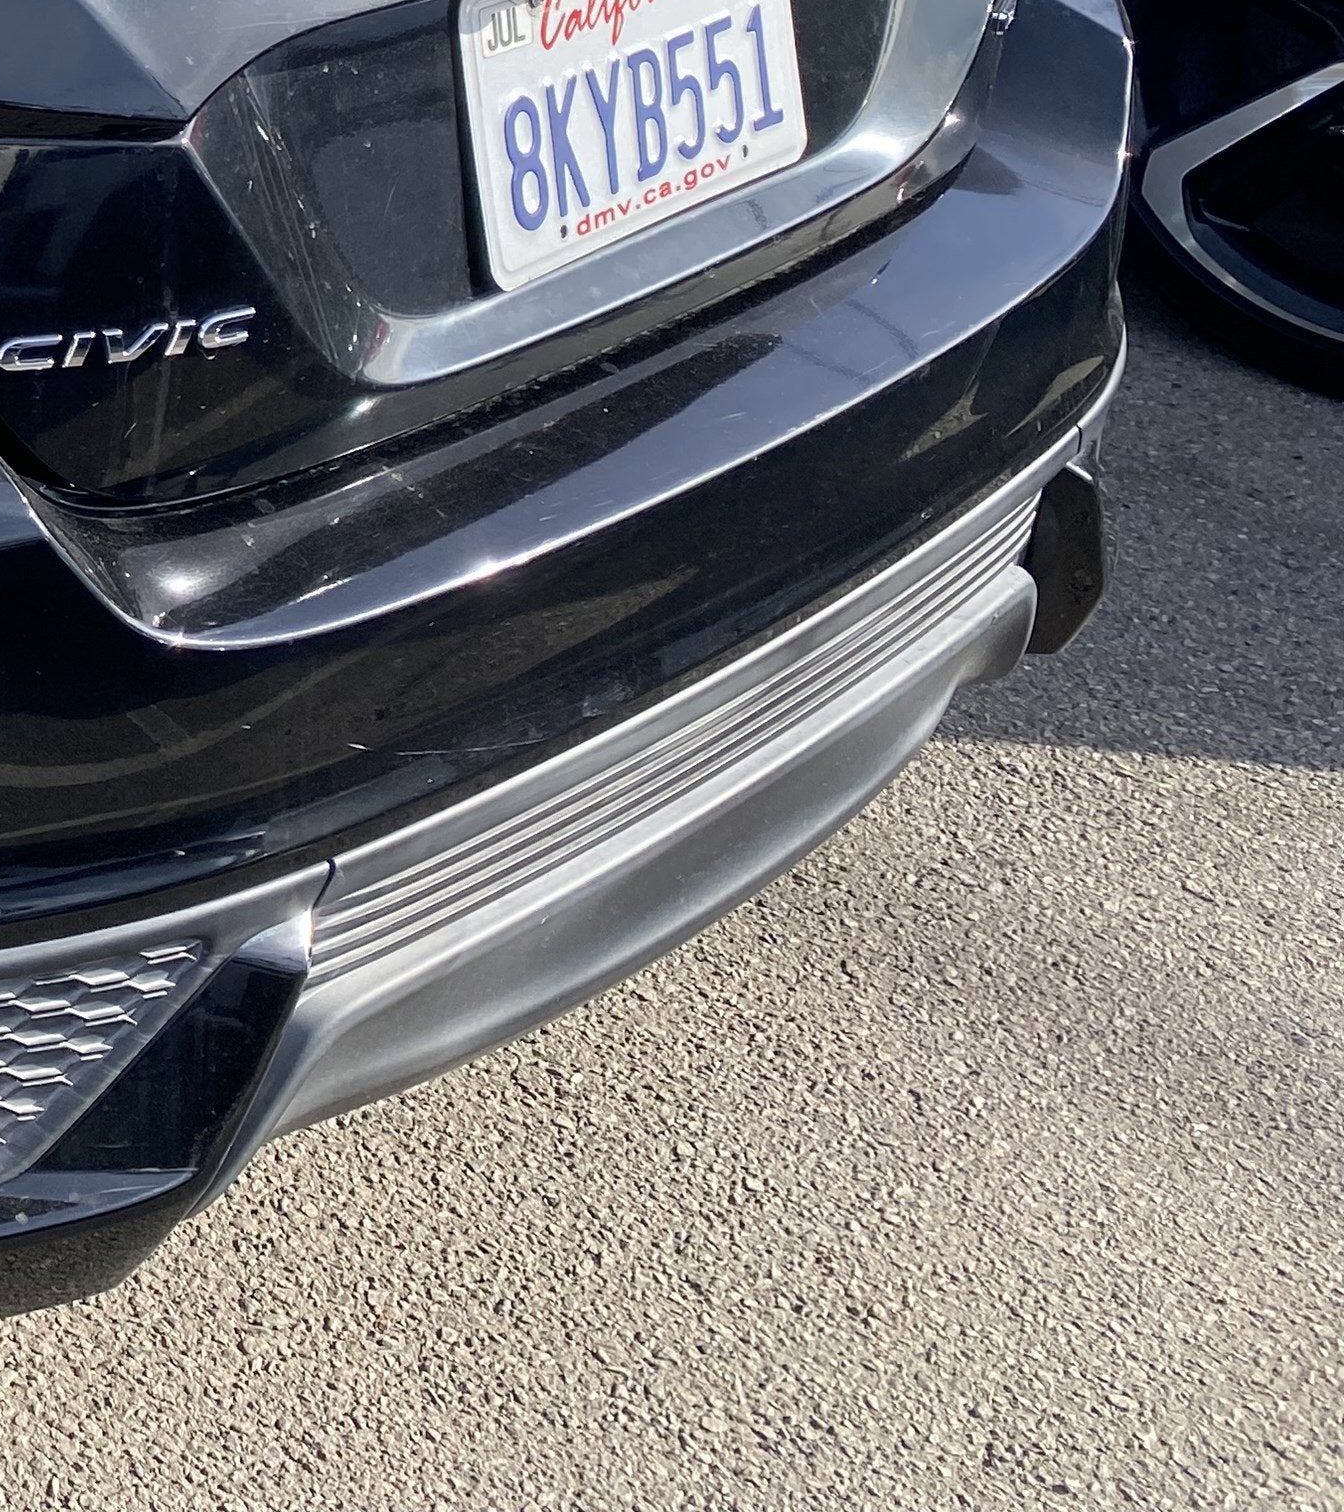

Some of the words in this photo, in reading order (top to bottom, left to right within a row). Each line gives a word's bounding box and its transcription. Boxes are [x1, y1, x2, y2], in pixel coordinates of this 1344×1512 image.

[487, 2, 527, 52] JUL
[503, 3, 784, 232] 8KYB551
[575, 153, 732, 238] dmv.ca.gov
